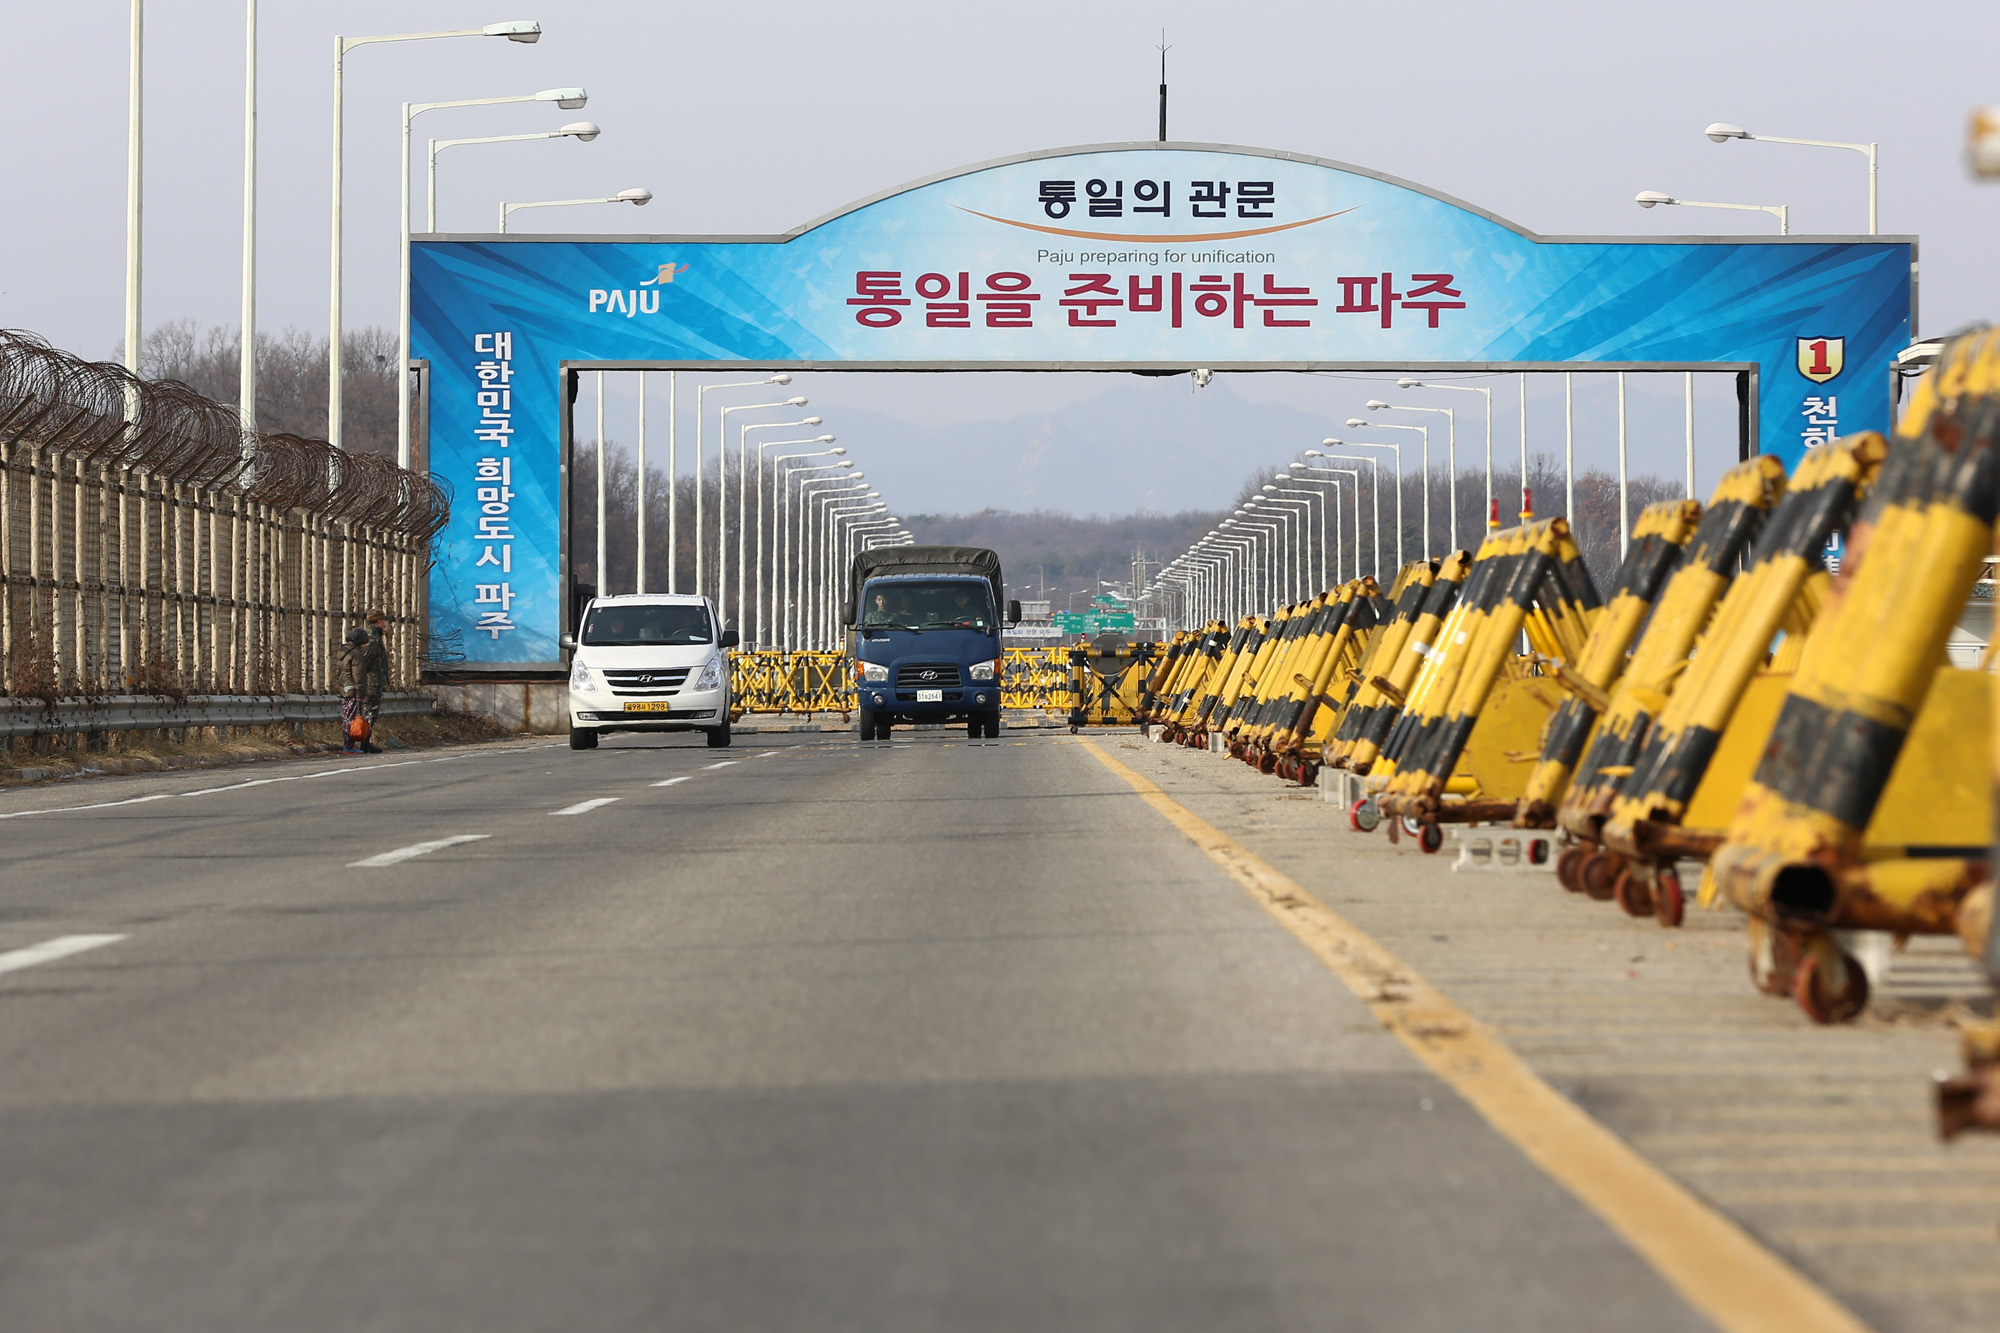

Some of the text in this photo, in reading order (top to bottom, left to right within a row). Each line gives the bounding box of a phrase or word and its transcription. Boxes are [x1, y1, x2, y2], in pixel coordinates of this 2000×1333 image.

[1038, 178, 1275, 218] 통일의 관문
[1037, 248, 1275, 267] Paju preparing for unification
[589, 289, 660, 318] PAJU
[847, 271, 1466, 329] 통일을 준비하는 파주
[1809, 341, 1831, 374] 1
[473, 331, 516, 640] 대한민국 희망도시 파주
